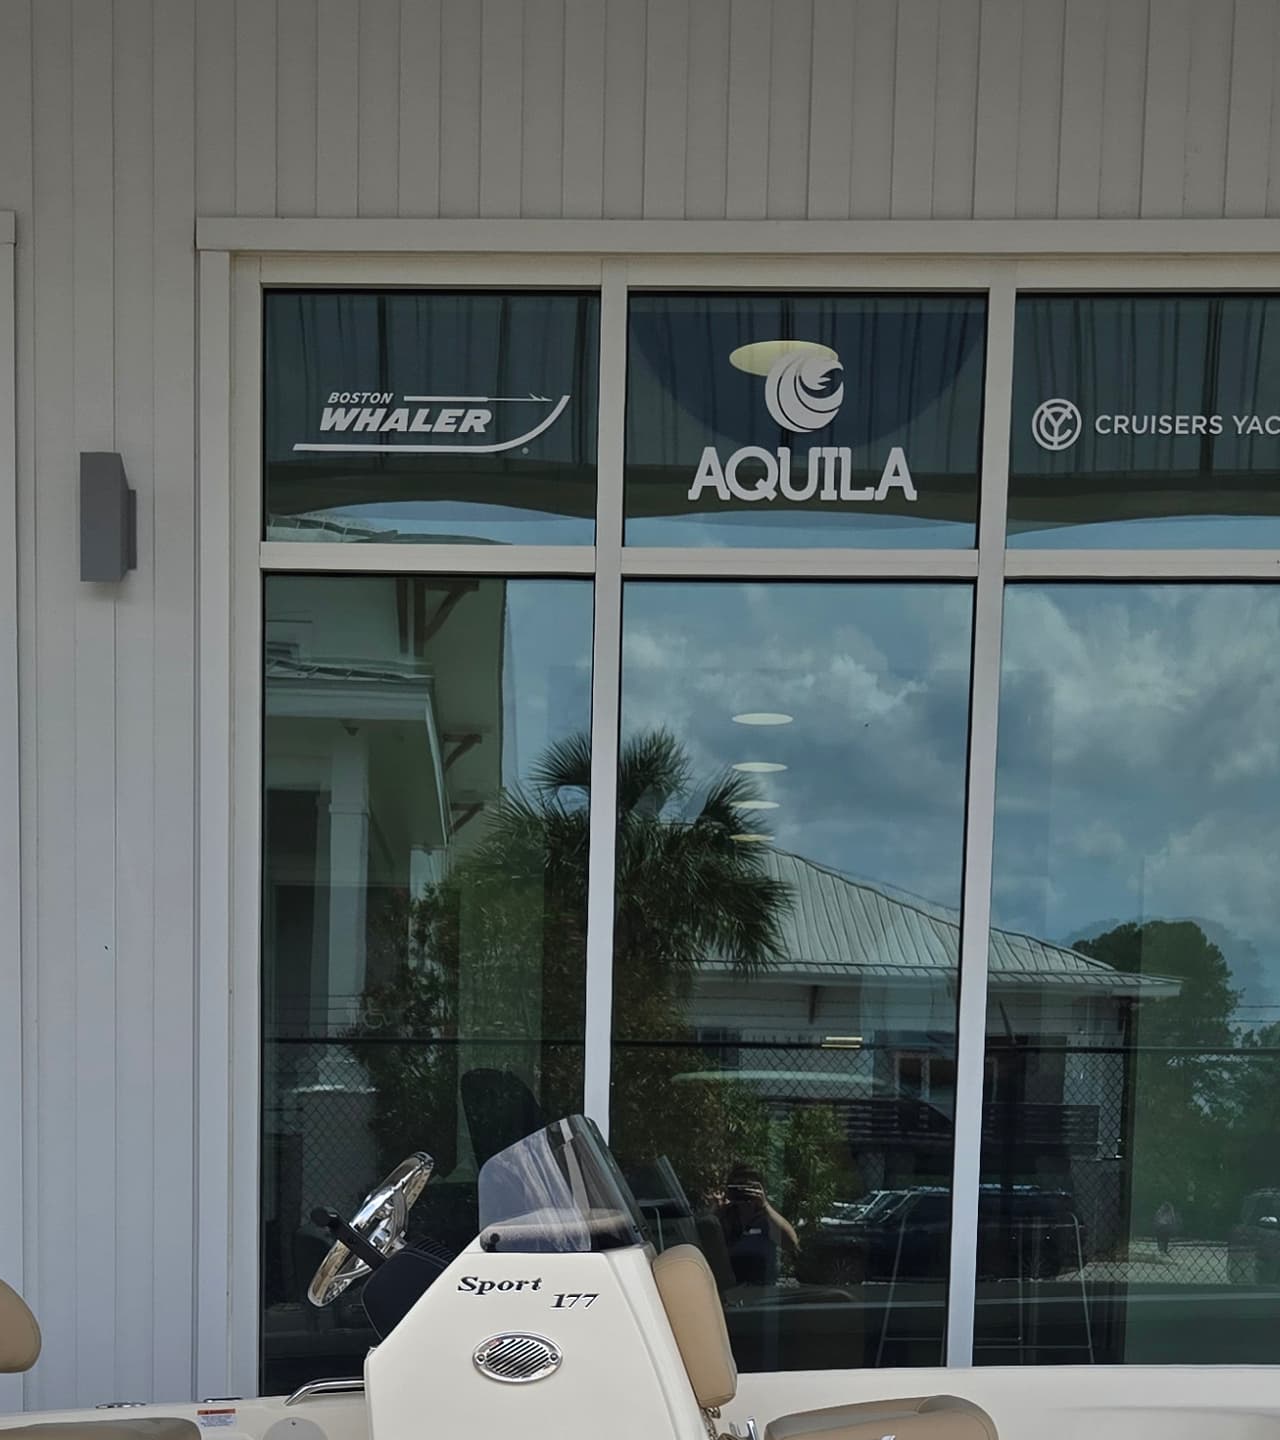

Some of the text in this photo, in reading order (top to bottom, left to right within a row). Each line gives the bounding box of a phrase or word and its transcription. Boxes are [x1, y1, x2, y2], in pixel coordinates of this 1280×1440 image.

[327, 392, 394, 404] BOSTON
[320, 407, 493, 433] WHALER
[1095, 415, 1223, 435] CRUISERS
[687, 446, 918, 501] AQUILA
[457, 1276, 543, 1296] Sport
[551, 1293, 600, 1309] 177
